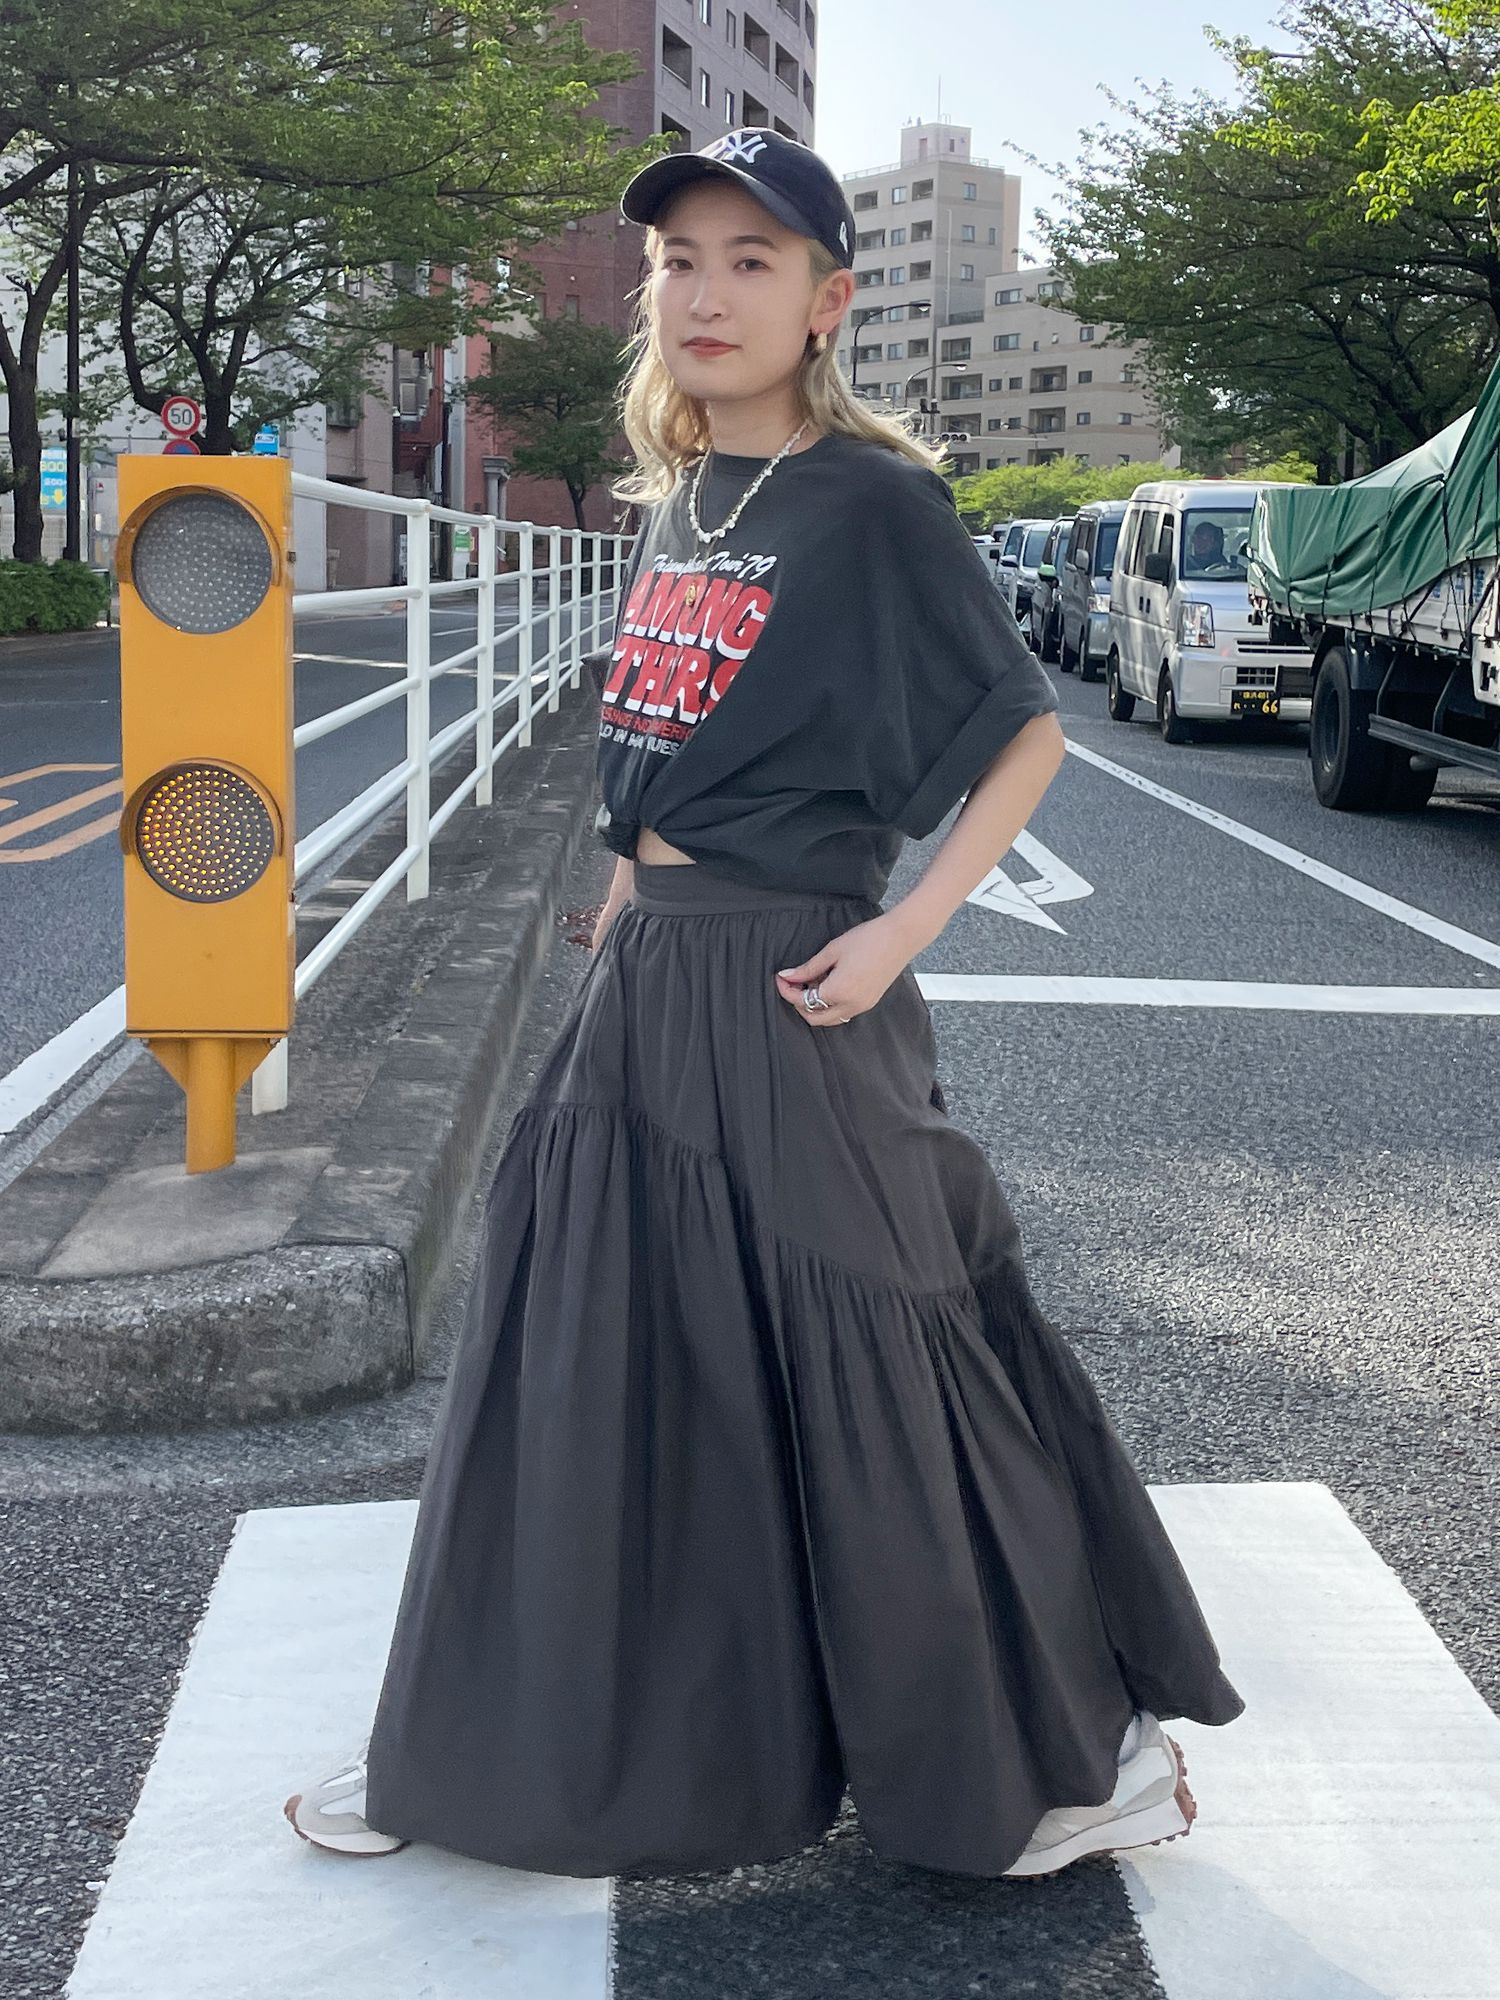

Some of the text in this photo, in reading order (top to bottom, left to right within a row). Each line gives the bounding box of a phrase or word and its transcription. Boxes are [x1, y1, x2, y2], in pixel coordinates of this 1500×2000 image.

[170, 407, 193, 426] 50
[711, 550, 745, 572] Tour
[1262, 699, 1278, 714] 66
